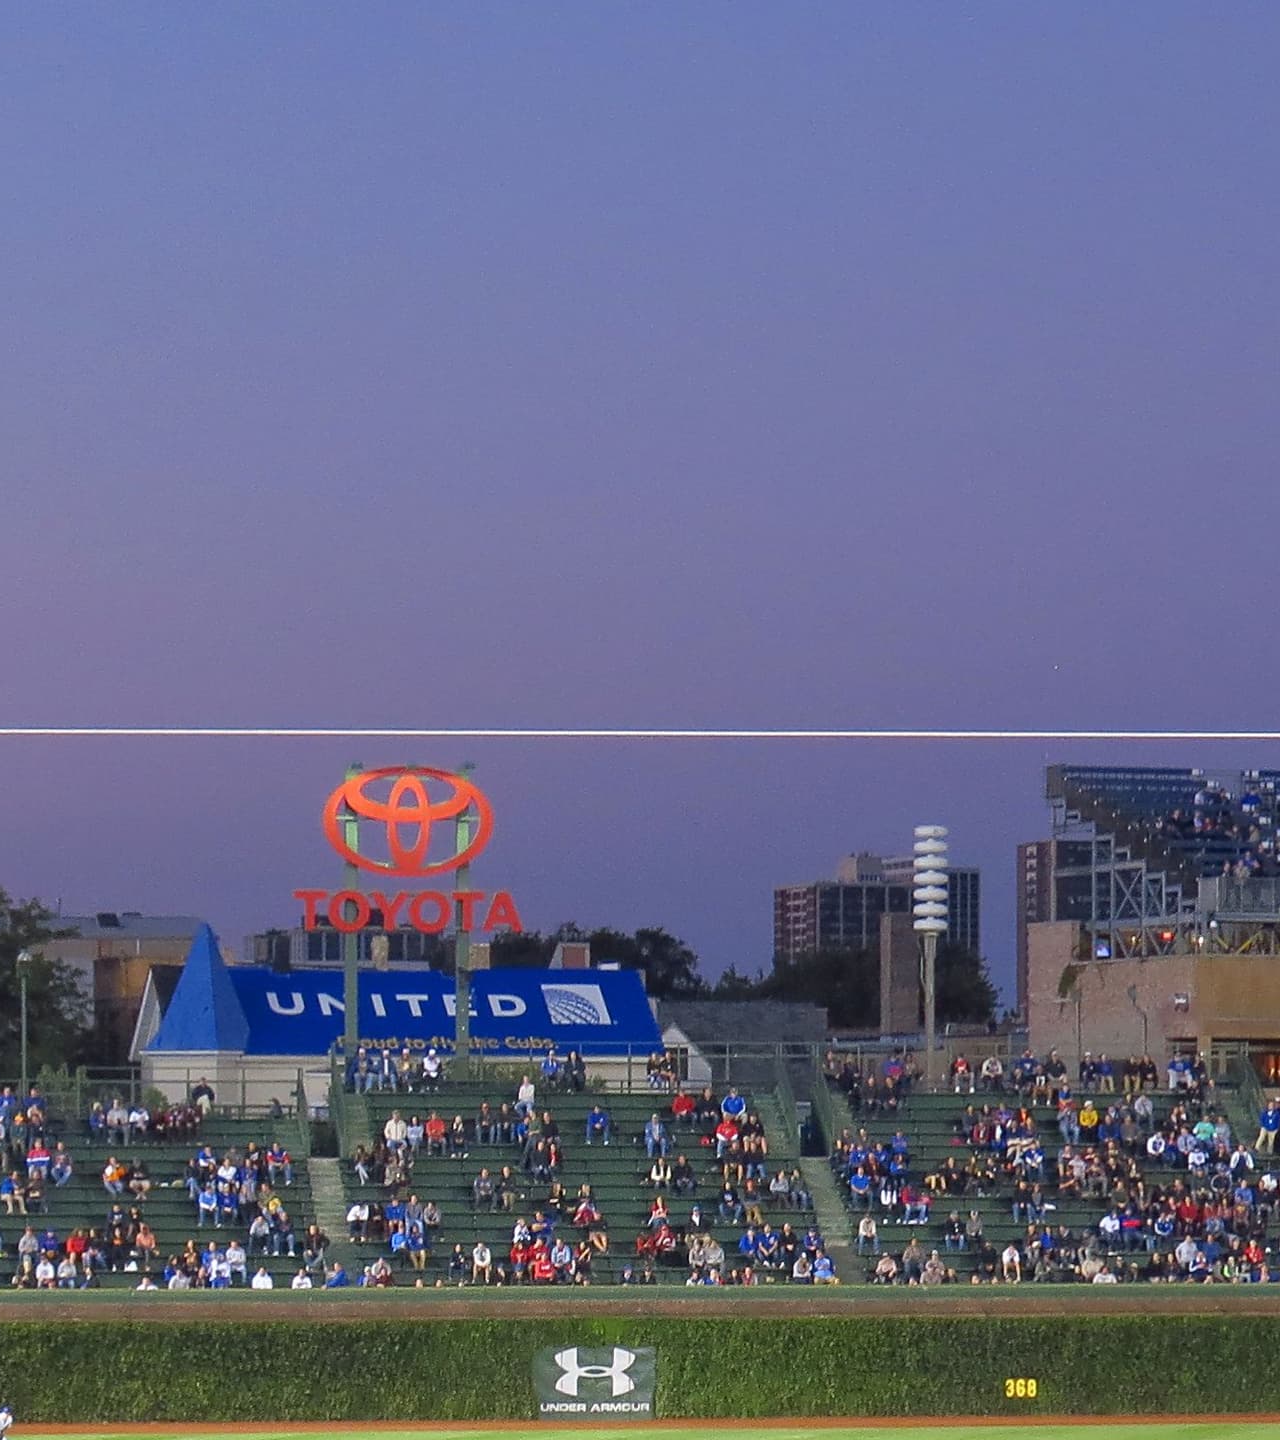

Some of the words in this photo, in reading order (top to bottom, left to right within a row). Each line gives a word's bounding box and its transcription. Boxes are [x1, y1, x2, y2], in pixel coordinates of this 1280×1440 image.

[293, 889, 523, 934] TOYOTA
[266, 992, 526, 1017] UNITED
[337, 1036, 399, 1049] Poud
[405, 1037, 426, 1049] to
[1005, 1379, 1037, 1398] 368
[540, 1403, 586, 1412] UNDER
[590, 1403, 650, 1412] ARMOUR
